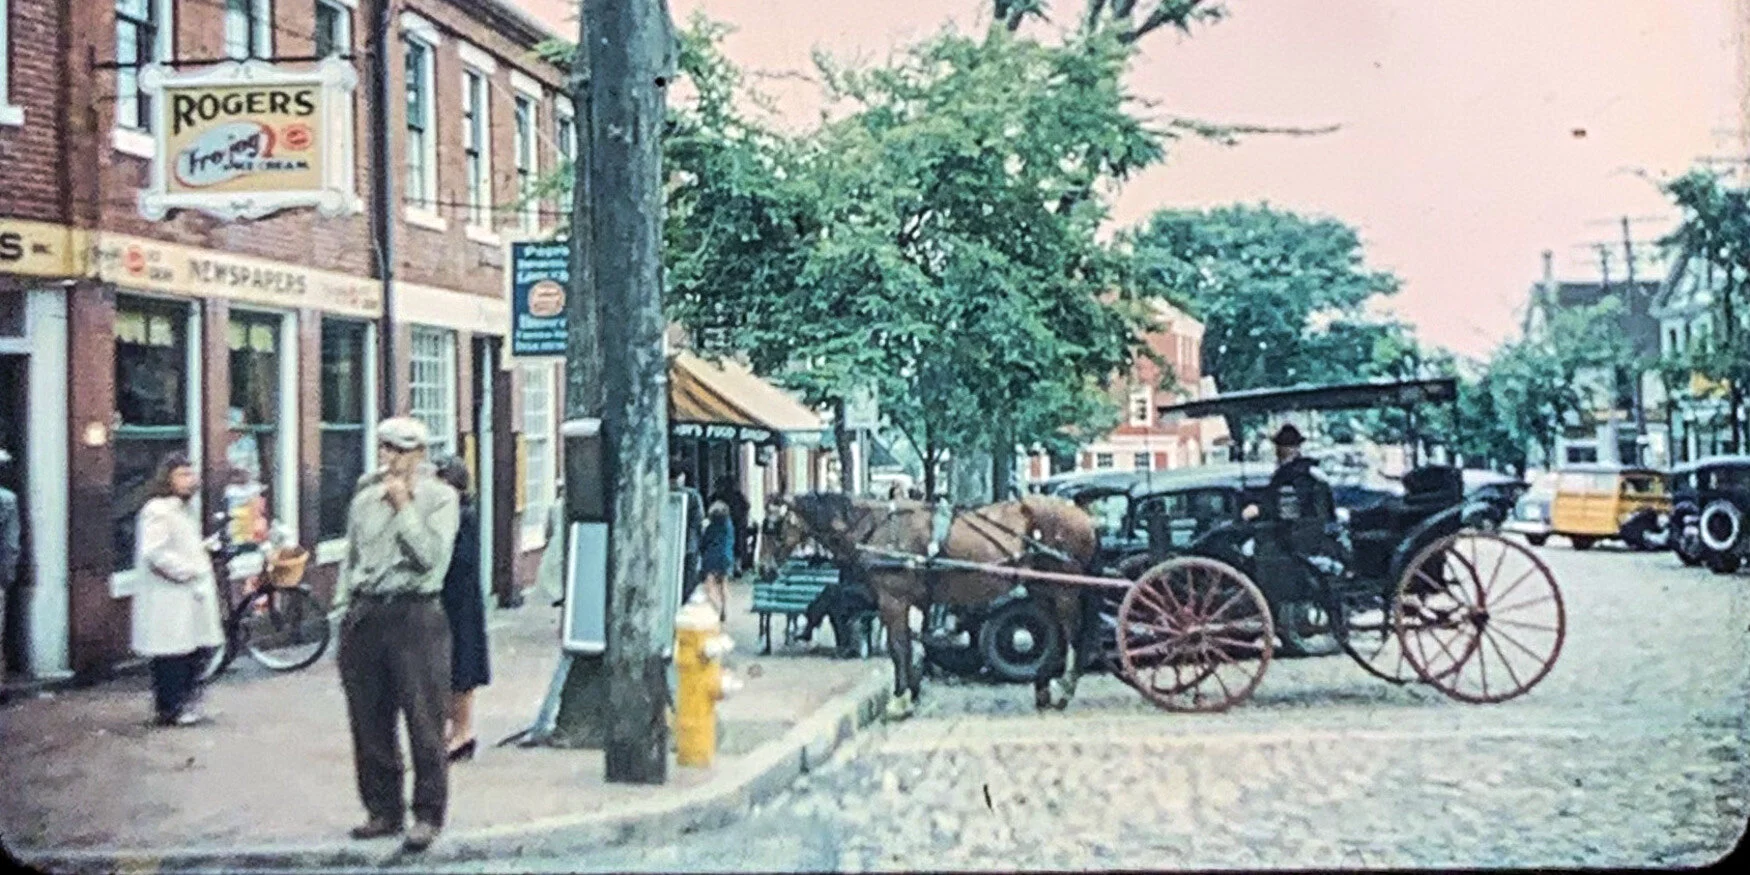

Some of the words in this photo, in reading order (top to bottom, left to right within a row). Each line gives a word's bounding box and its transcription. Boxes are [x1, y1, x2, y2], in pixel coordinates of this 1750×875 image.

[172, 90, 315, 136] ROGERS
[0, 232, 24, 261] S
[189, 258, 307, 295] NEWSPAPERS
